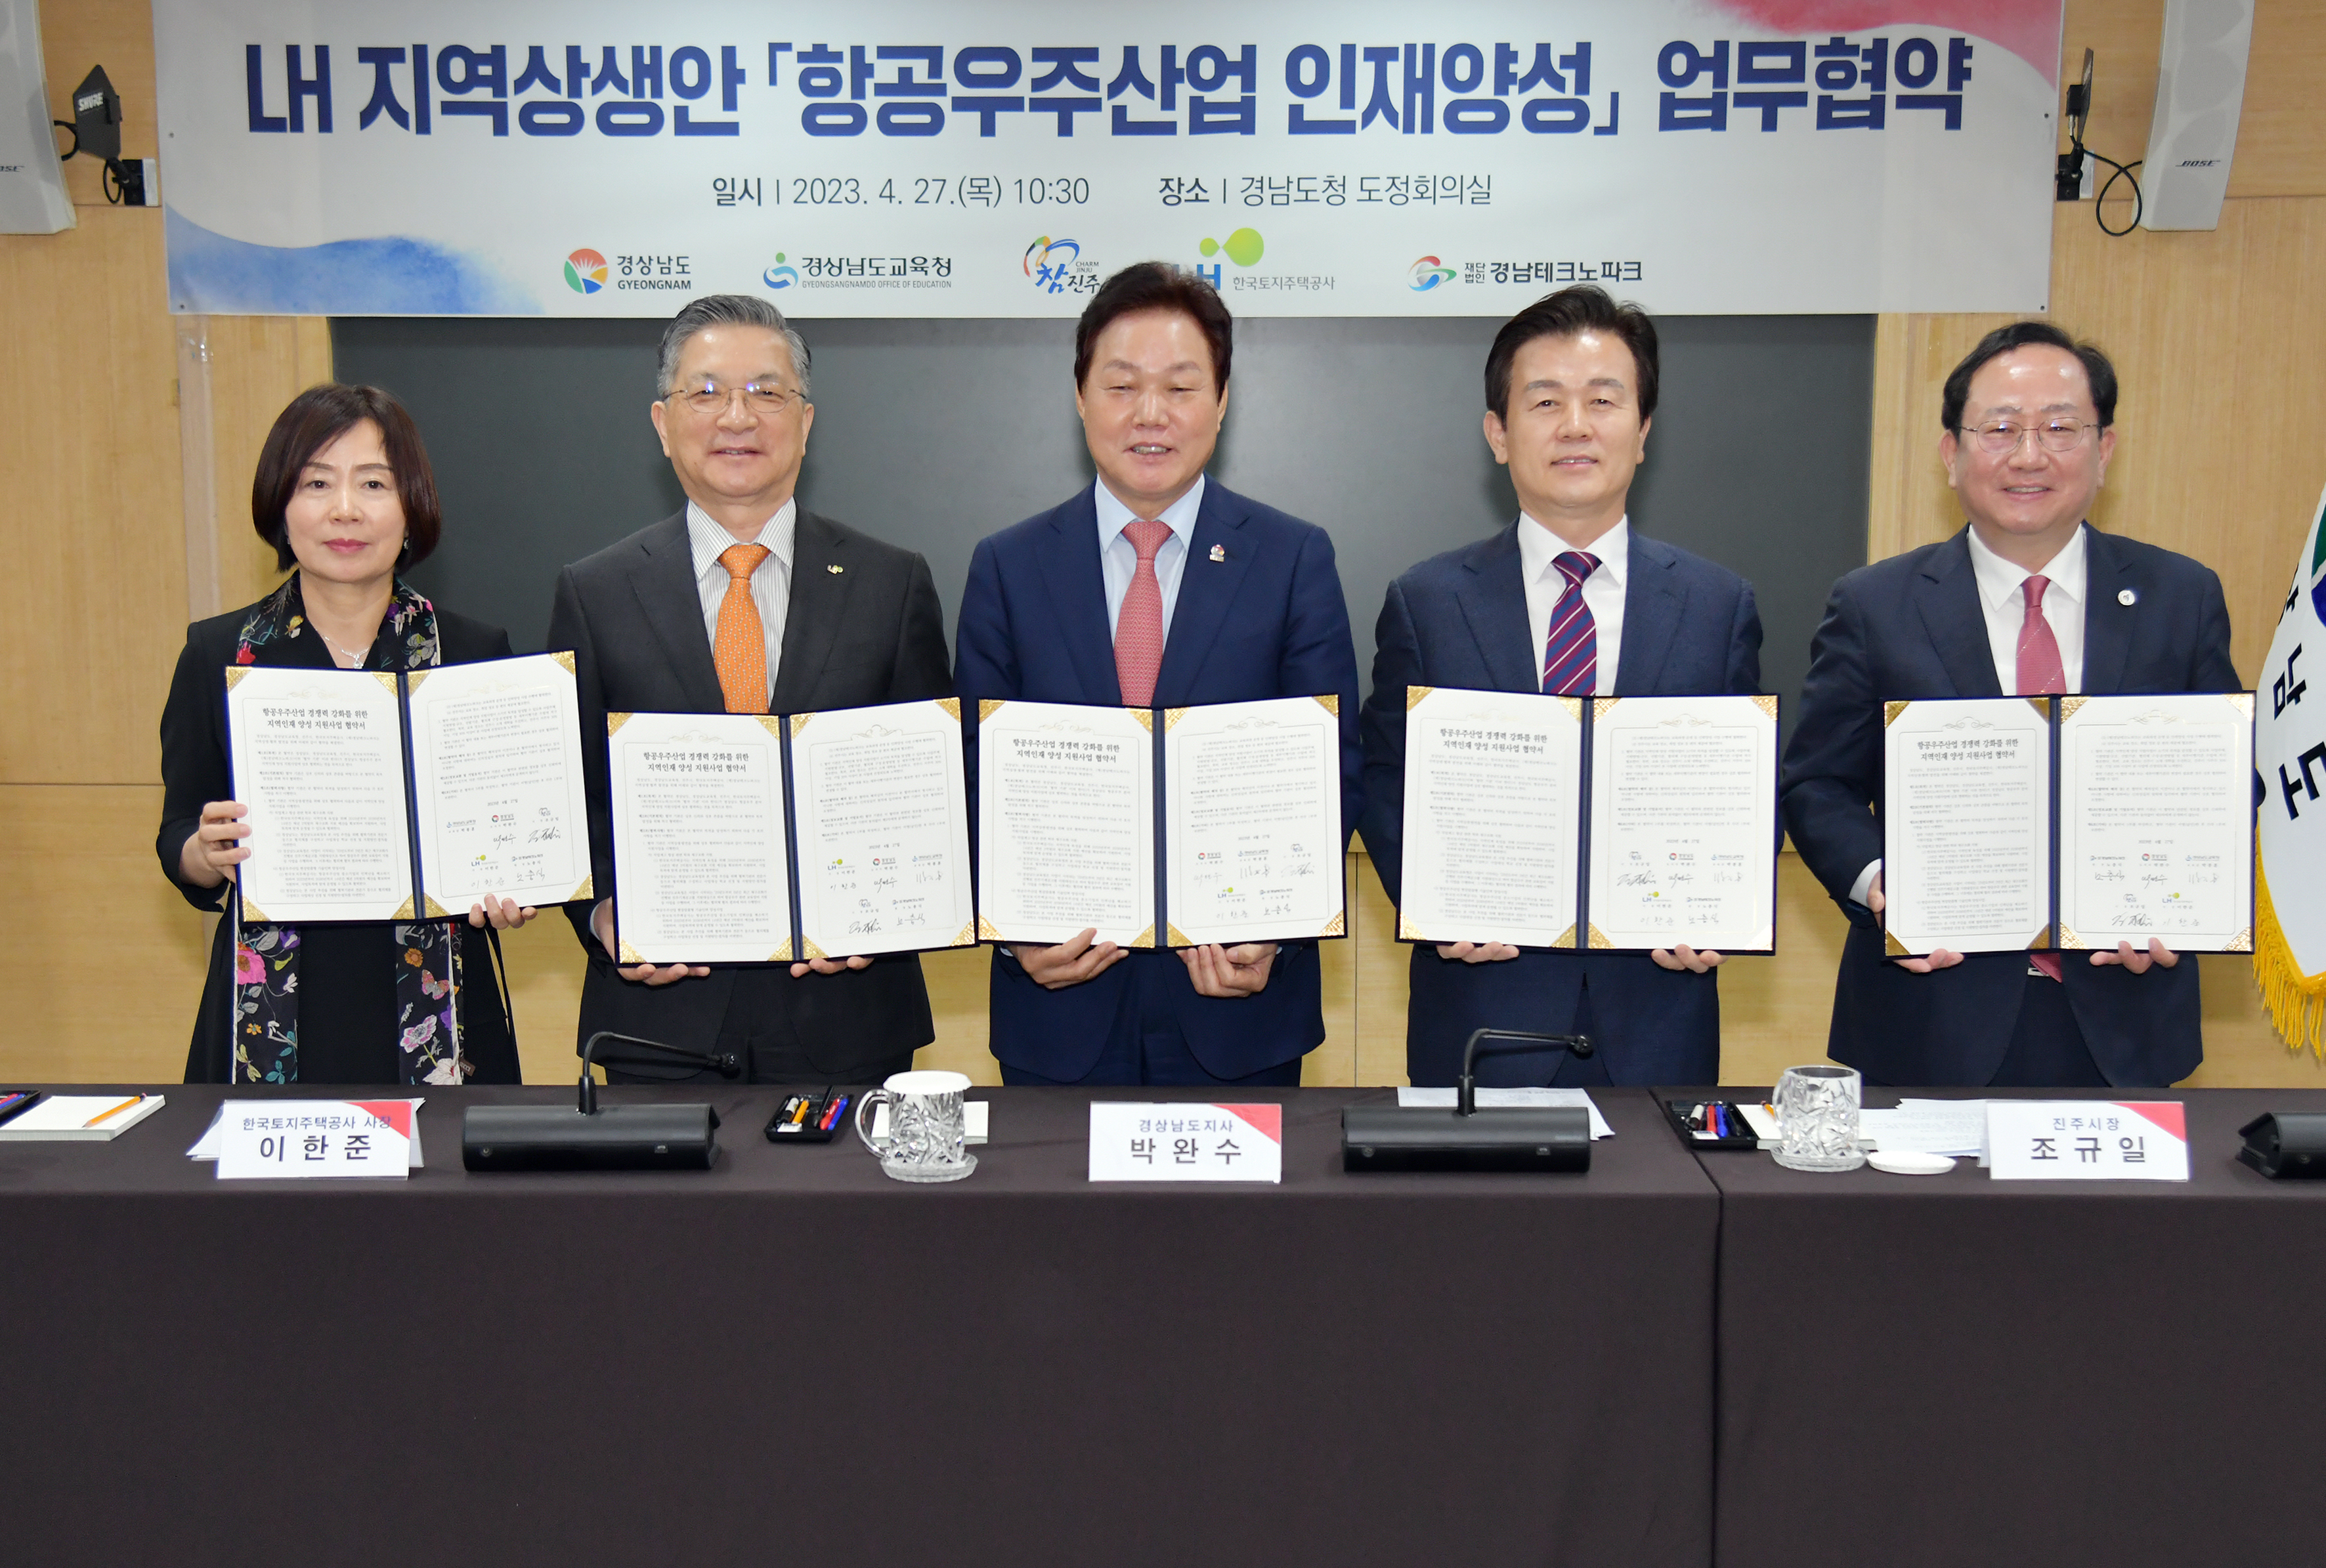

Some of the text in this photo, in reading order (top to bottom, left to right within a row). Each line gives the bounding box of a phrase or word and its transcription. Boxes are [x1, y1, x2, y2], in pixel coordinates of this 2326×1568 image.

[246, 45, 333, 133] 내
[356, 43, 746, 137] 지역상생안
[1657, 36, 1972, 132] 업무협약
[78, 92, 104, 112] SHURE
[713, 175, 1490, 208] 일시 2023. 4. 27.(목) 10:30 장소 경남도청 도정회의실
[617, 255, 691, 276] 경상남도
[802, 257, 951, 277] 경상남도교육청
[1465, 263, 1486, 272] 재단
[1490, 261, 1643, 284] 경남테크노파크
[618, 280, 691, 290] GYEONGNAM
[1035, 263, 1069, 294] 참
[1068, 274, 1100, 294] 진주
[1233, 276, 1335, 290] 한국토지주택공사
[1465, 273, 1485, 284] 법인
[263, 708, 305, 717] 항공우주산업
[331, 710, 352, 718] 강화를
[355, 710, 368, 719] 위한
[1440, 729, 1482, 738] 항공우주산업
[1013, 738, 1055, 748] 항공우주산업
[1444, 740, 1471, 750] 지역인재
[1492, 743, 1519, 752] 지원사업
[1918, 740, 1957, 750] 항공우주산업
[1065, 752, 1092, 761] 지원사업
[1921, 752, 1947, 761] 지역인재
[1950, 752, 1963, 760] 양성
[1966, 752, 1992, 760] 지원사업
[243, 1116, 356, 1131] 한국토지주택공사
[1140, 1119, 1233, 1133] 경상남도지사
[2053, 1117, 2120, 1132] 진주시장
